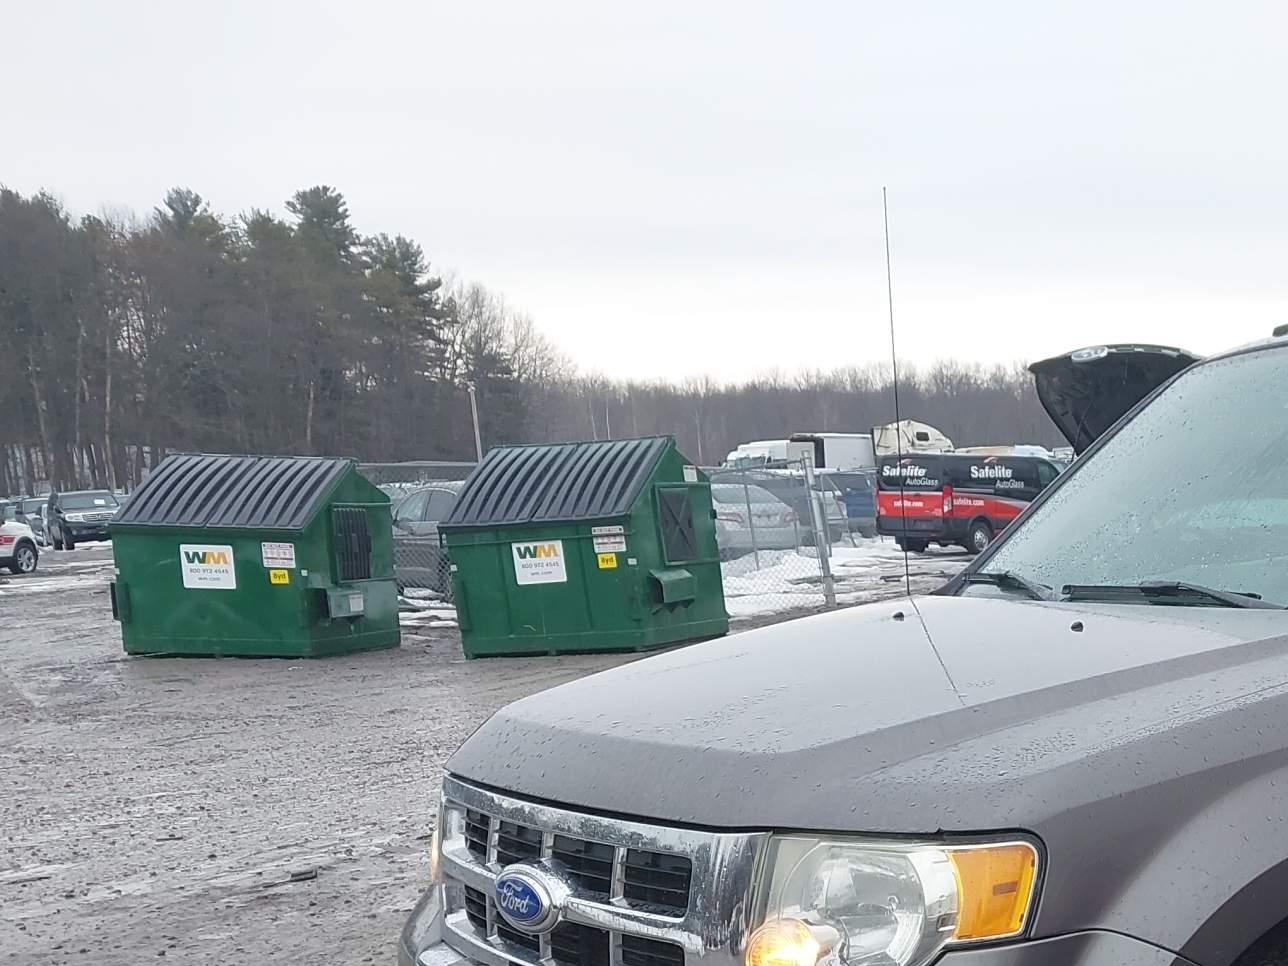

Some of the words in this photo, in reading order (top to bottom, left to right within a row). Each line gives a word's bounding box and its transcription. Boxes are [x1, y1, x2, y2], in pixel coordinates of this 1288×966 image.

[882, 465, 928, 477] Safelite
[970, 465, 1013, 478] Safelite
[905, 477, 939, 487] AutoGlass
[995, 479, 1025, 489] AutoGlass
[184, 551, 228, 564] WM
[515, 543, 560, 559] WM
[498, 881, 534, 914] Ford
